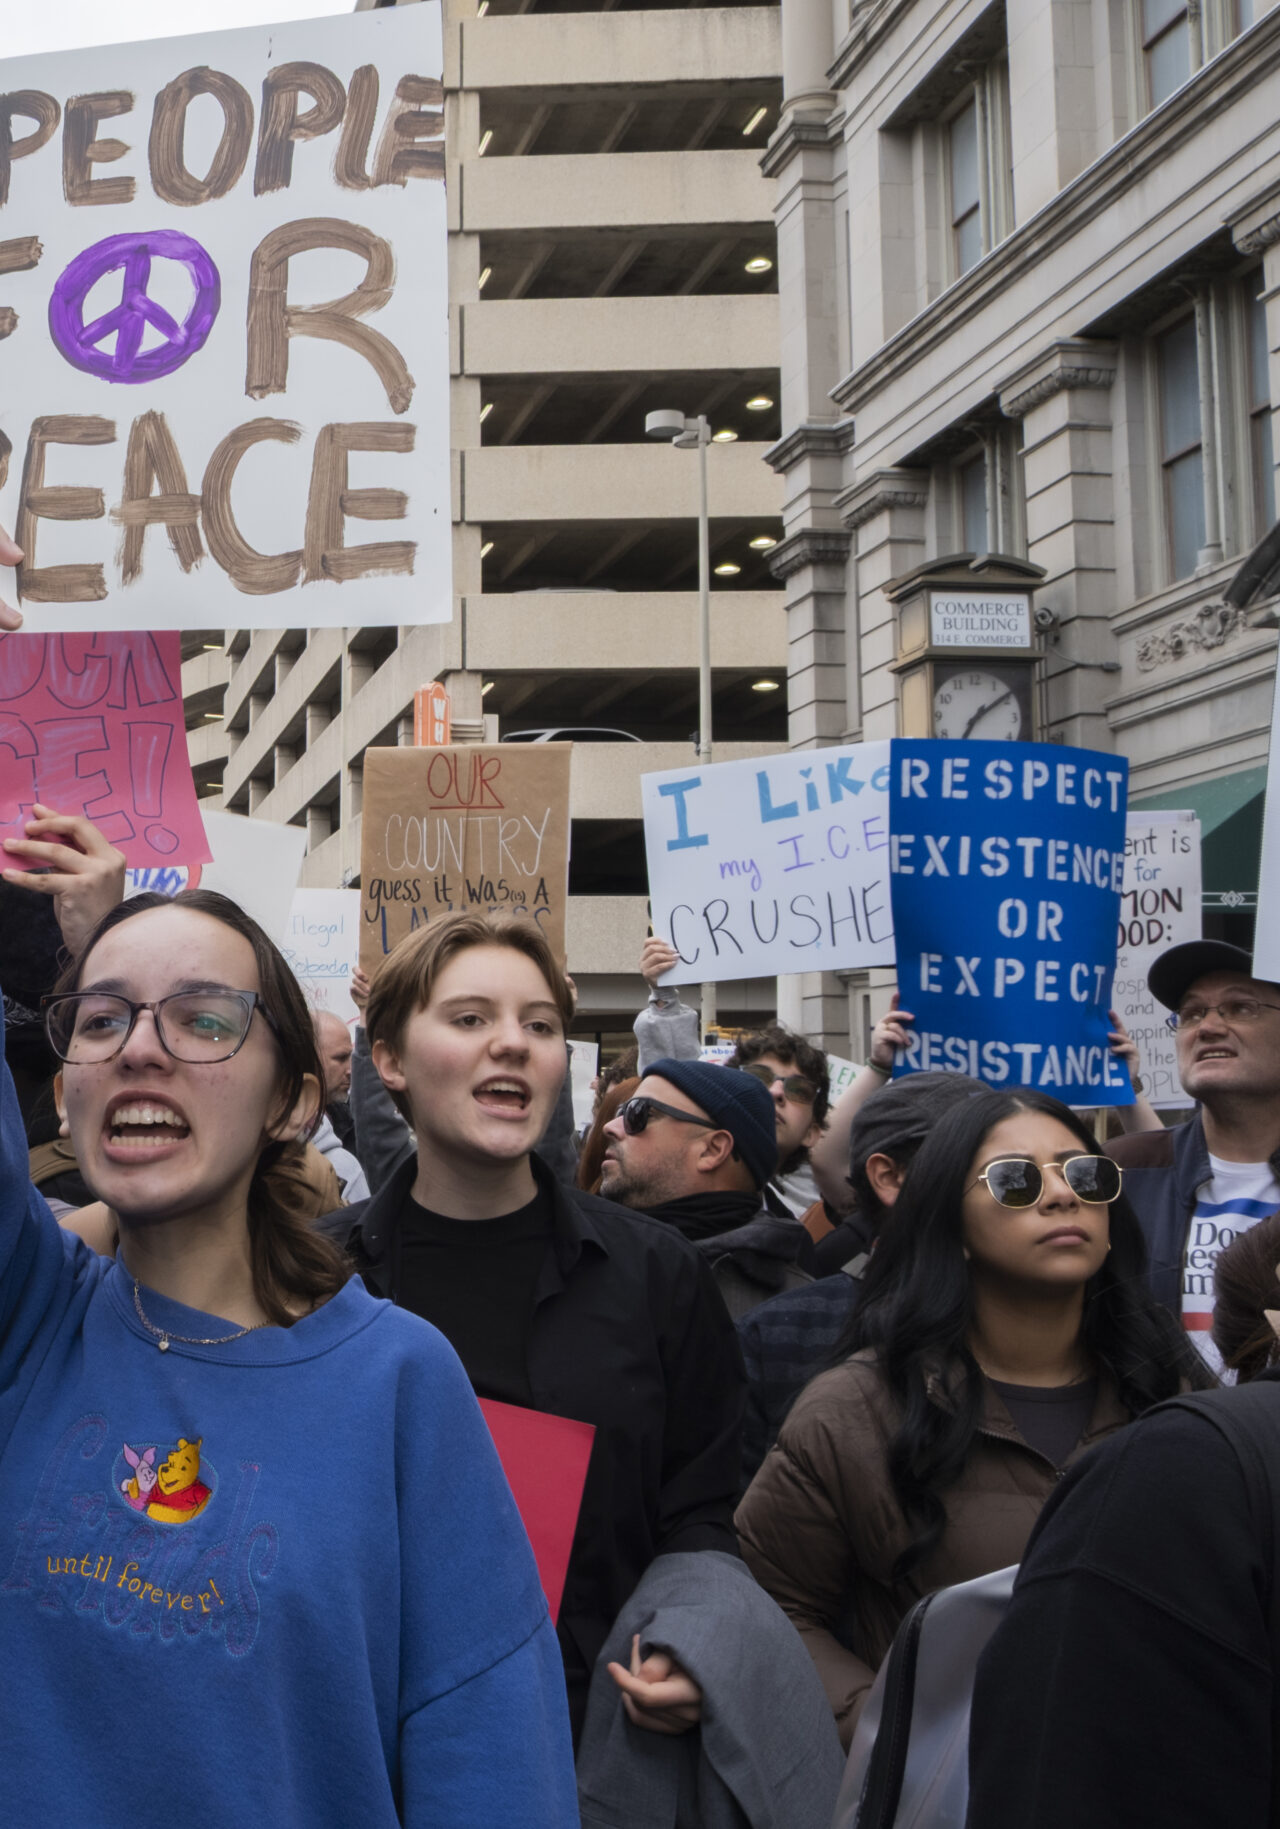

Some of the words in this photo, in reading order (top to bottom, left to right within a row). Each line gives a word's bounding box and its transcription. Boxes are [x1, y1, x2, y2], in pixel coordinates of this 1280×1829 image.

[935, 601, 1025, 616] COMMERCE
[943, 617, 1019, 632] BUILDING
[935, 635, 951, 643] 314
[965, 634, 1027, 645] COMMERCE
[953, 680, 963, 690] 11
[970, 675, 981, 686] 12
[992, 681, 996, 691] 1
[940, 694, 952, 704] 10
[934, 711, 942, 721] 9
[1011, 713, 1018, 723] 3
[428, 752, 504, 808] OUR
[901, 758, 1122, 813] RESPECT
[658, 776, 709, 852] I
[386, 808, 550, 876] COUNTRY
[1172, 829, 1191, 853] is
[720, 859, 762, 891] my
[890, 834, 1125, 893] EXISTENCE
[1134, 858, 1162, 882] for
[365, 877, 421, 923] guess
[434, 874, 453, 903] it
[533, 877, 549, 904] A
[670, 880, 894, 965] CRUSHE
[998, 898, 1063, 942] OR
[920, 953, 1106, 1005] EXPECT
[1125, 1002, 1154, 1016] and
[895, 1029, 1124, 1087] RESISTANCE
[1147, 1047, 1176, 1066] the
[47, 1554, 112, 1583] until
[117, 1562, 224, 1613] forever!
